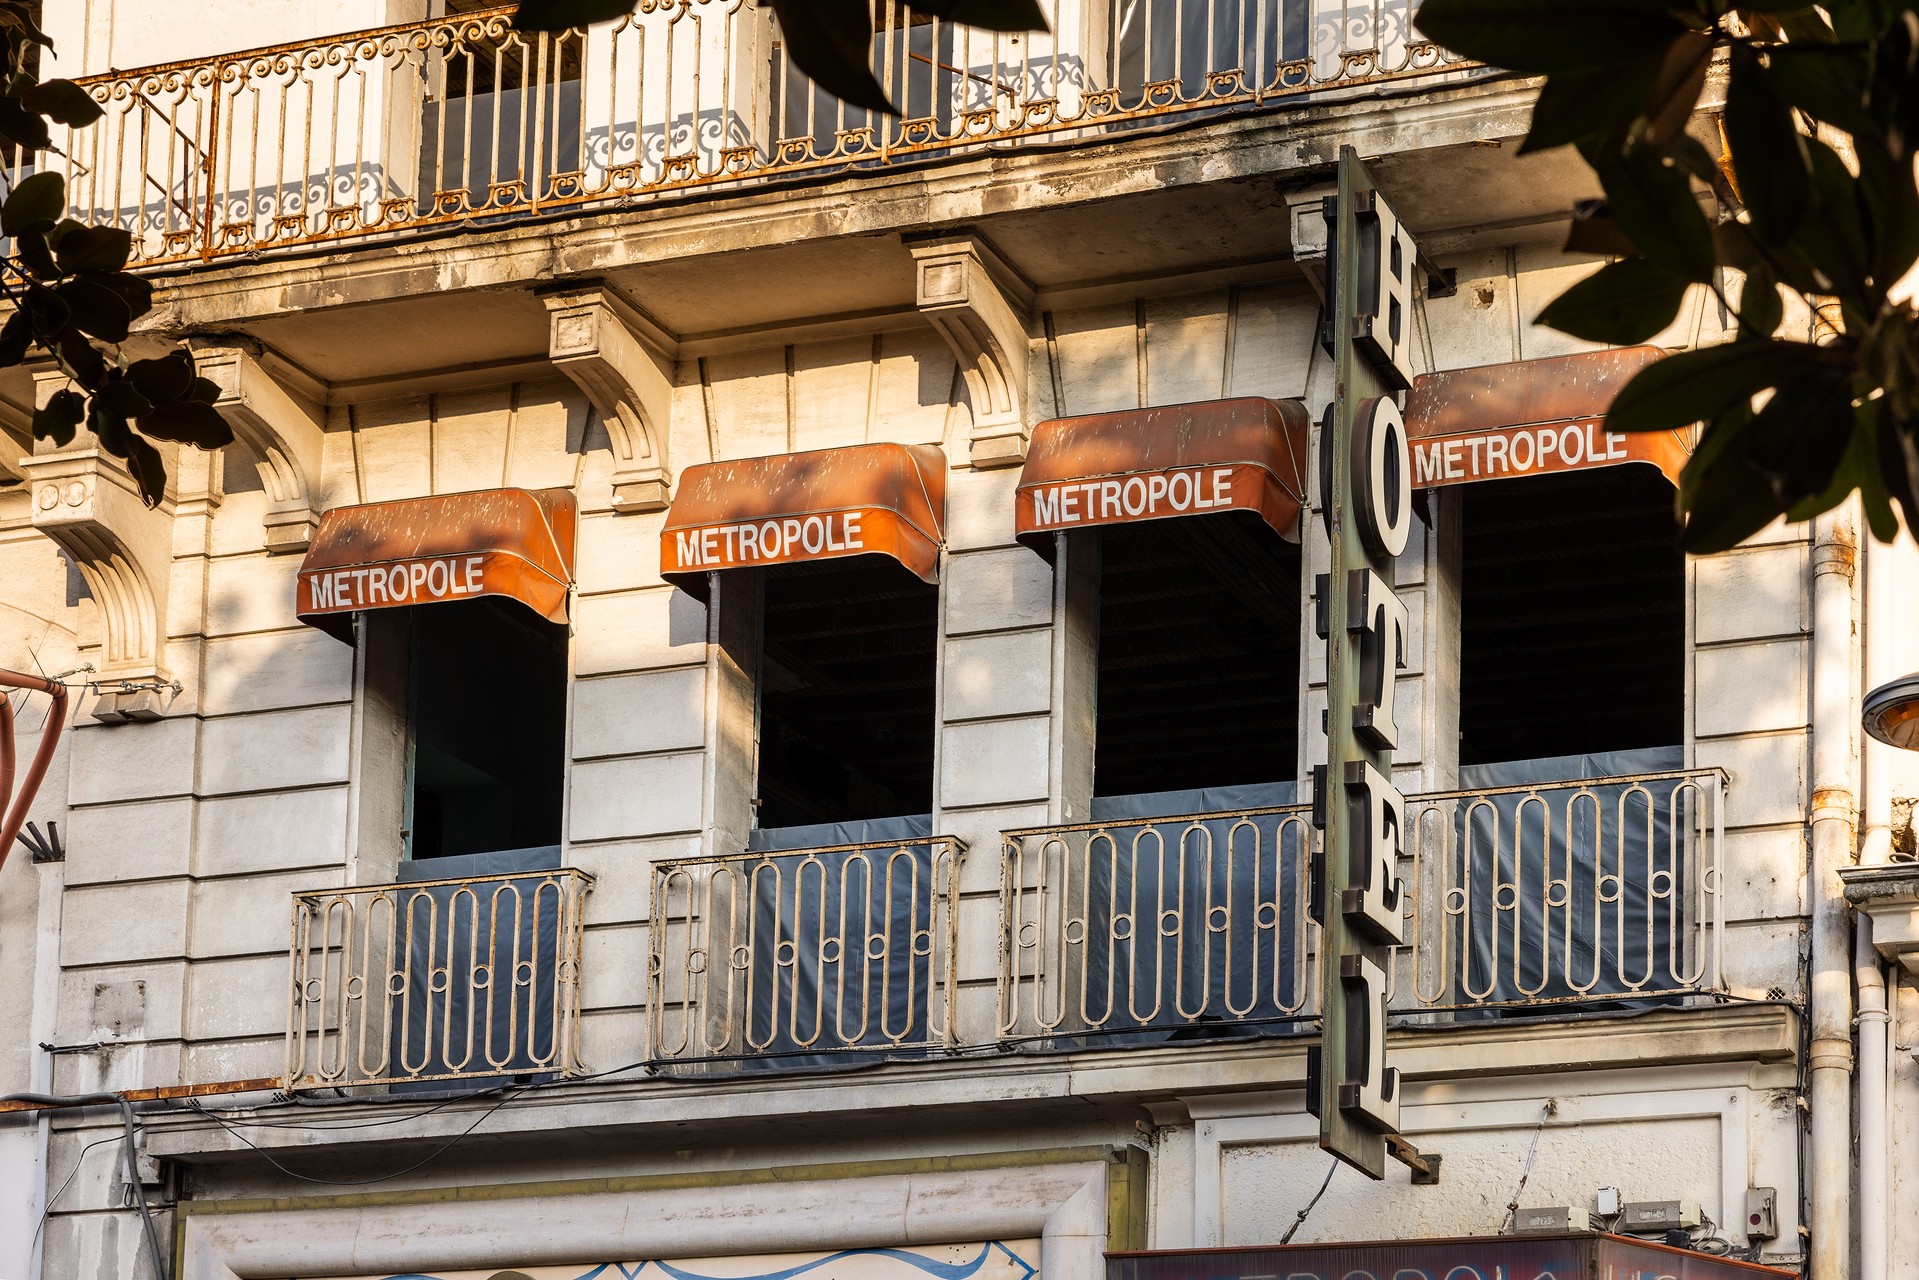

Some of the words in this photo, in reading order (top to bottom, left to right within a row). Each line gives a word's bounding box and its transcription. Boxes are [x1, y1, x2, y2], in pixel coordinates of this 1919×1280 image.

[1414, 425, 1627, 483] METROPOLE
[1033, 469, 1233, 526] METROPOLE
[677, 512, 863, 567] METROPOLE
[311, 556, 484, 609] METROPOLE
[1340, 190, 1417, 1134] HOTEL
